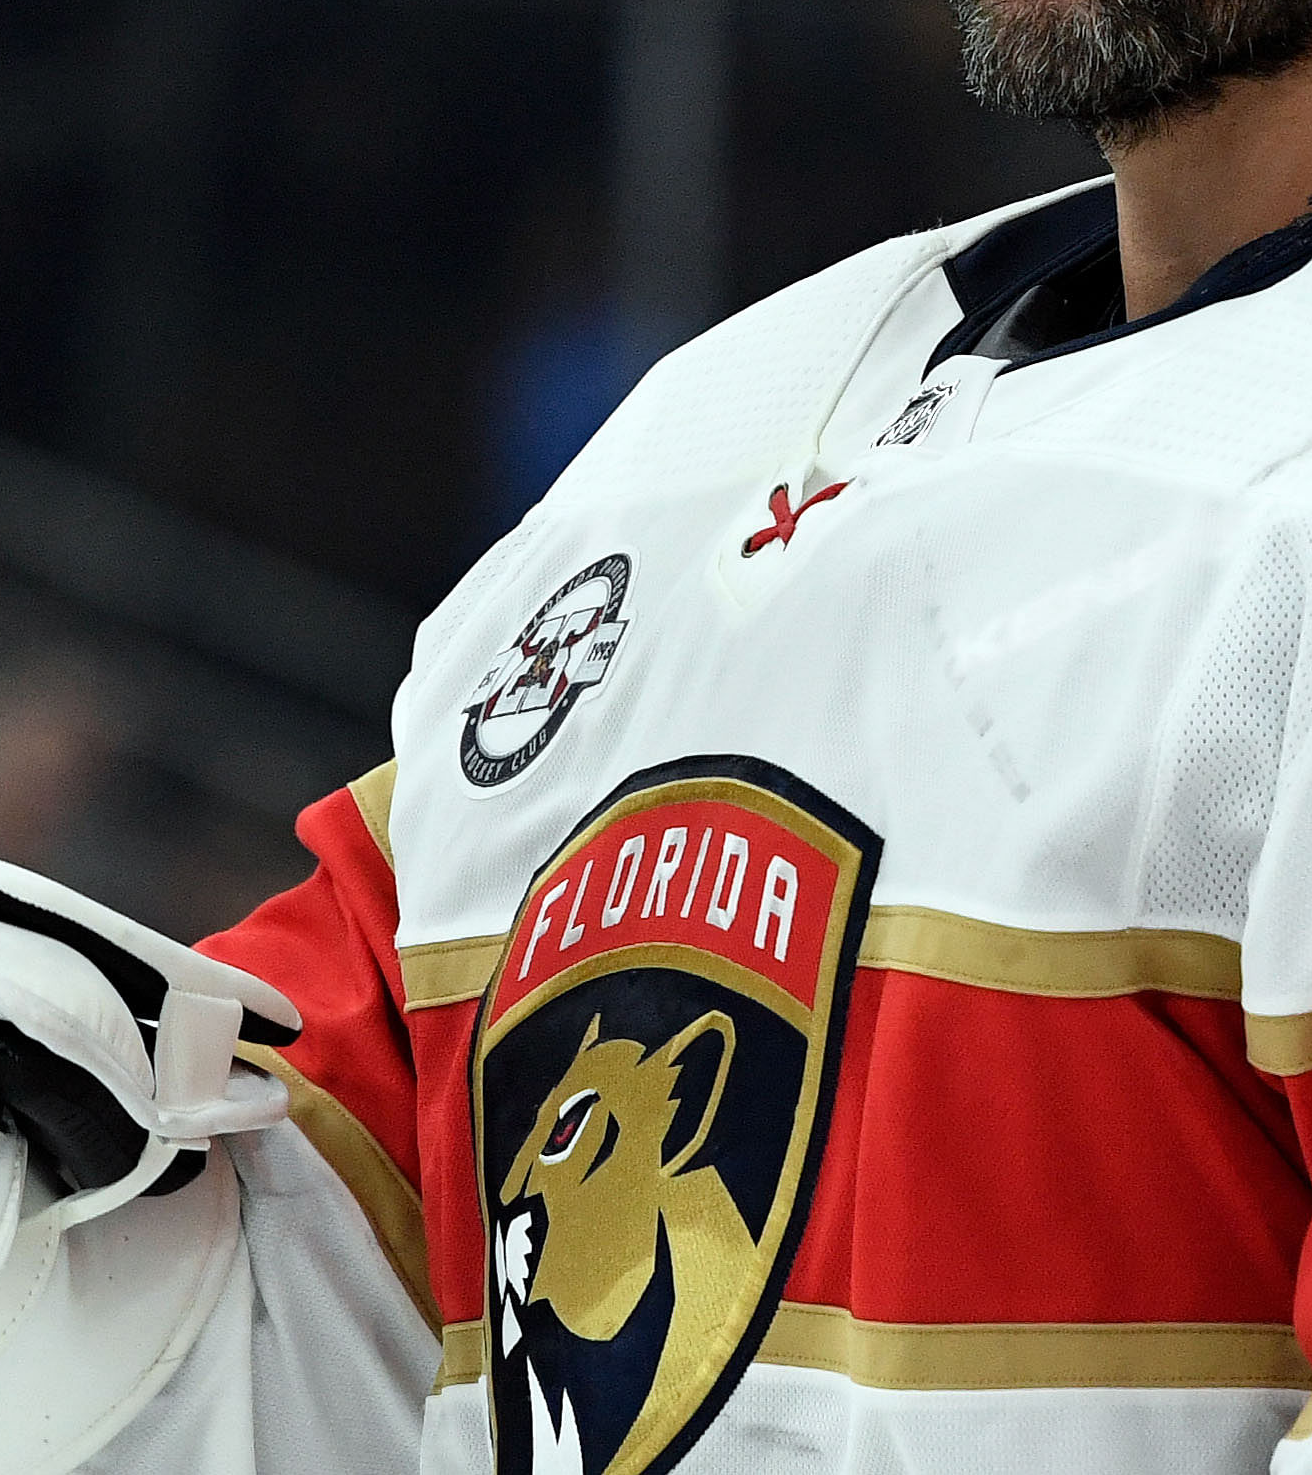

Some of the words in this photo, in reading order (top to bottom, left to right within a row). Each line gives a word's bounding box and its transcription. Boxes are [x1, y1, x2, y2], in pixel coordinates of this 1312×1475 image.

[587, 639, 617, 663] 1993
[511, 728, 548, 772] CLUB
[517, 826, 799, 982] FLORIDA
